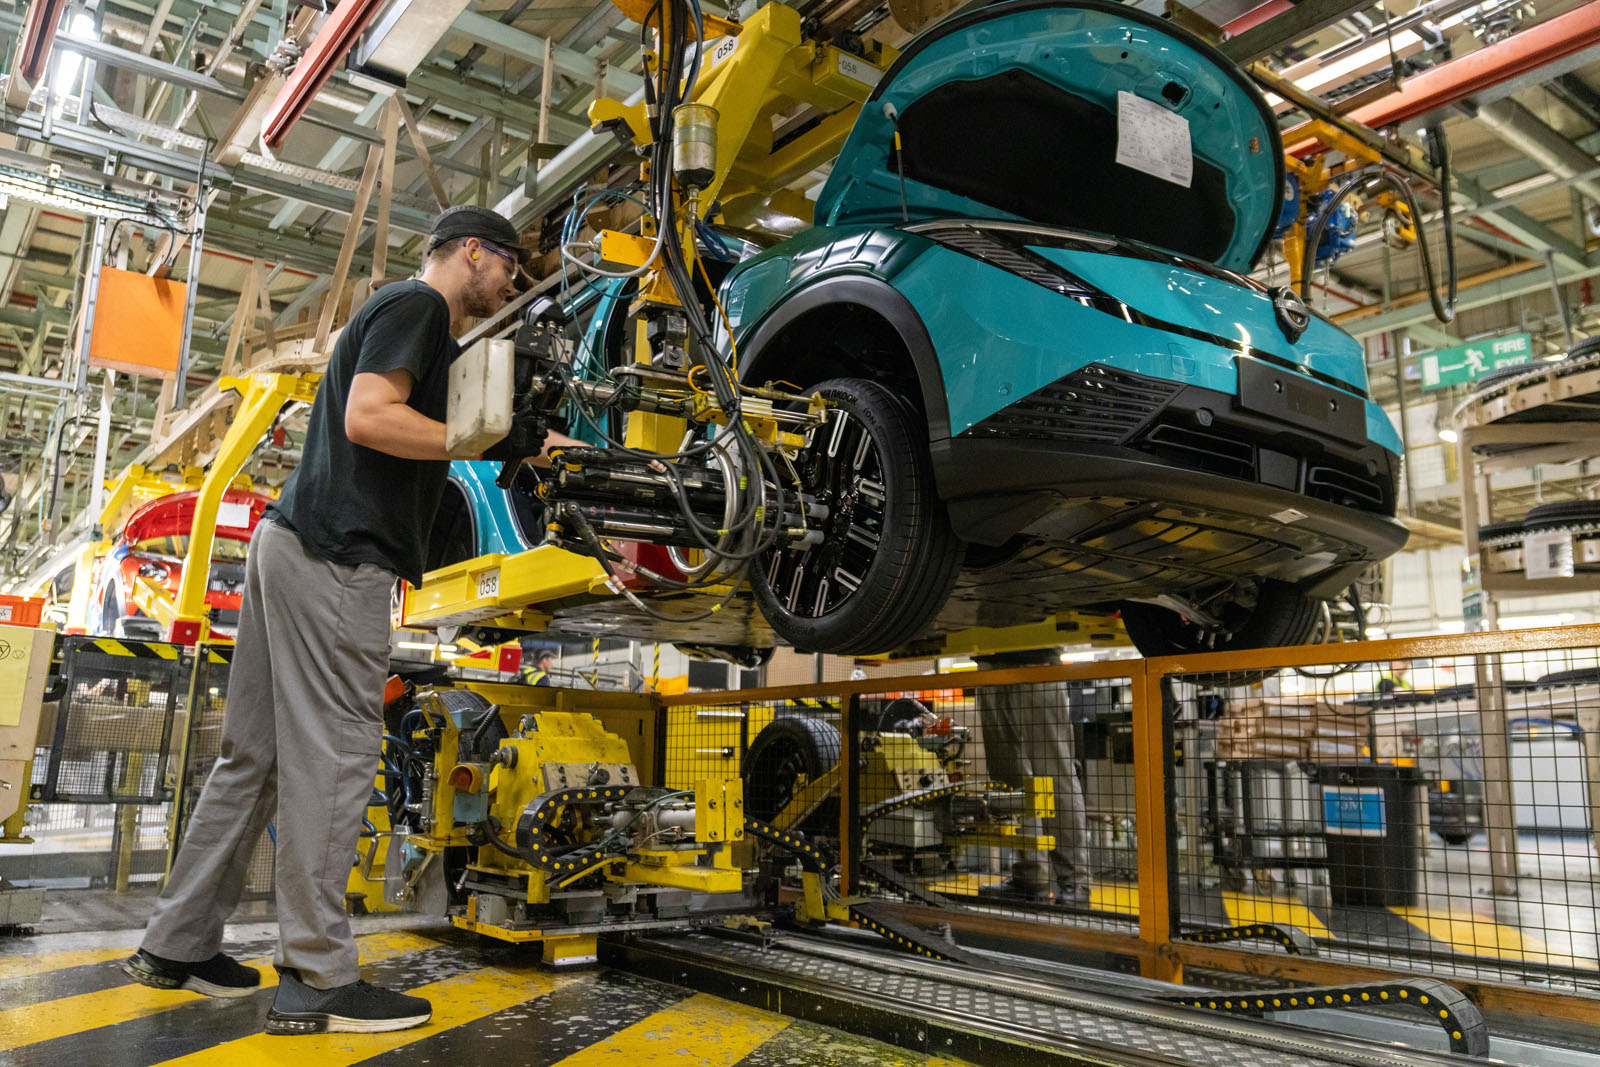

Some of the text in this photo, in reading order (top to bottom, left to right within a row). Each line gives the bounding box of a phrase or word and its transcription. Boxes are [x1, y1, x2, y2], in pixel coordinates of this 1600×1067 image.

[717, 39, 734, 59] 058
[841, 60, 857, 74] 058
[1493, 338, 1526, 355] FIRE
[480, 576, 497, 596] 058
